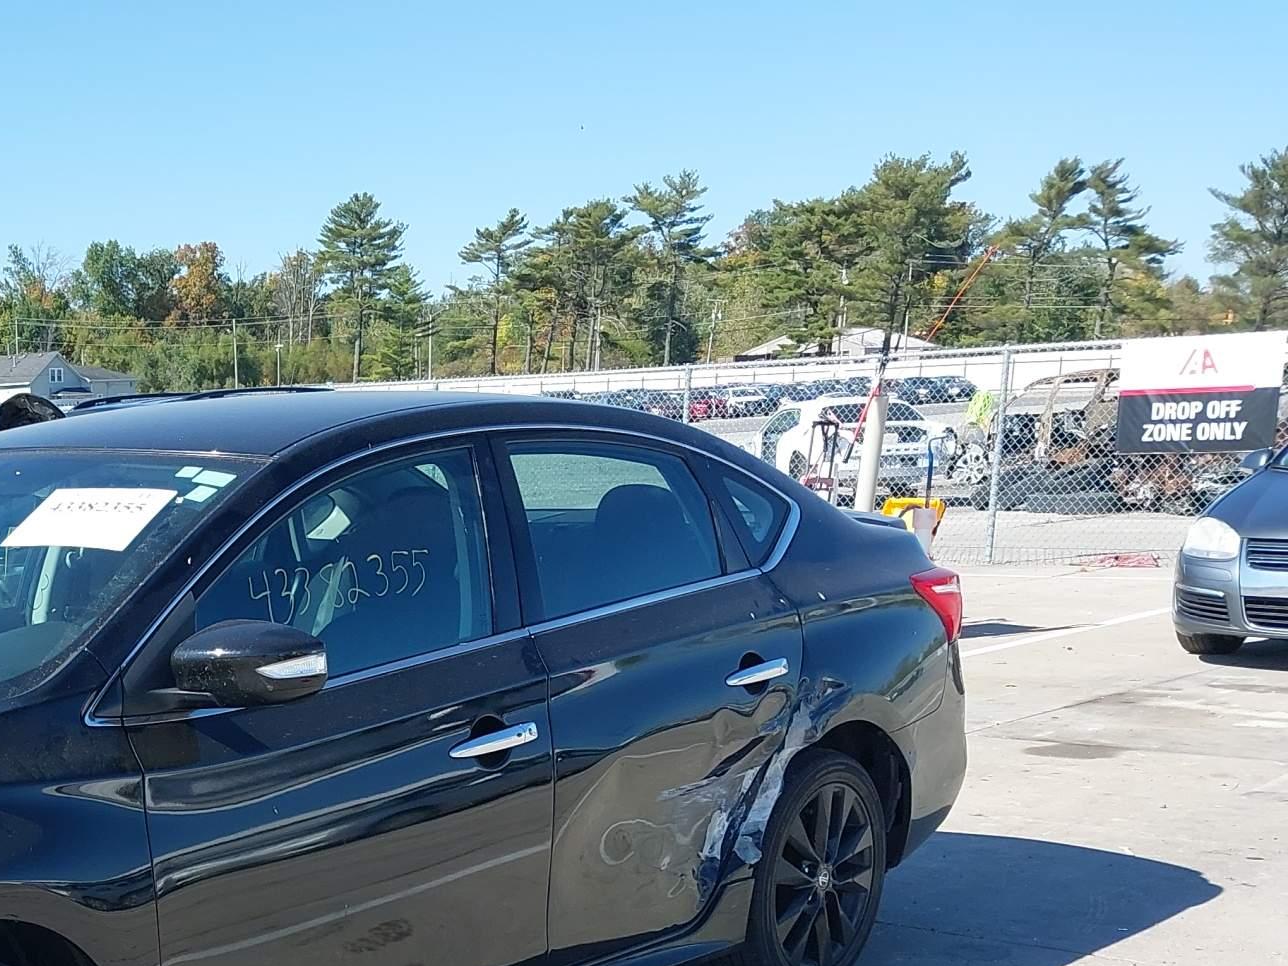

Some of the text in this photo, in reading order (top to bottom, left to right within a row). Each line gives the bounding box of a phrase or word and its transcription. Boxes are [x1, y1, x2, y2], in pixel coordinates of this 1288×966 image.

[1151, 400, 1243, 421] DROP OFF
[1141, 421, 1248, 442] ZONE ONLY
[248, 549, 429, 625] 43382355
